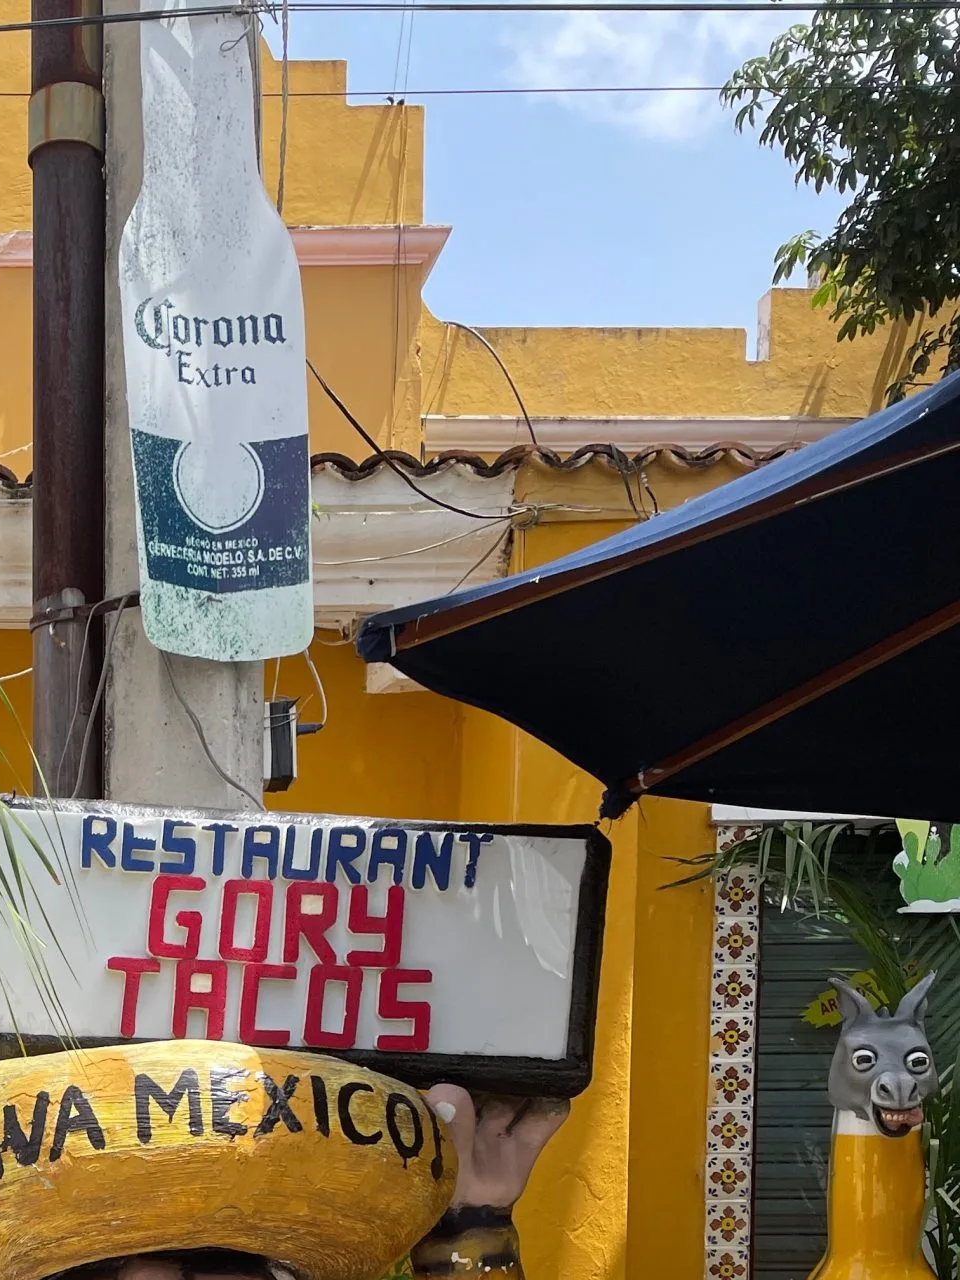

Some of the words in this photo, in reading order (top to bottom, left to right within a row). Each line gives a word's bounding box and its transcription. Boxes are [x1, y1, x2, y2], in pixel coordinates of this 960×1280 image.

[134, 297, 287, 357] Corona
[176, 350, 257, 388] Extra
[211, 541, 223, 551] EN
[268, 546, 283, 561] DE
[231, 566, 247, 578] 355
[248, 564, 260, 576] ml
[81, 815, 494, 891] RESTAURANT
[147, 874, 405, 968] GORY
[107, 956, 433, 1052] TACOS
